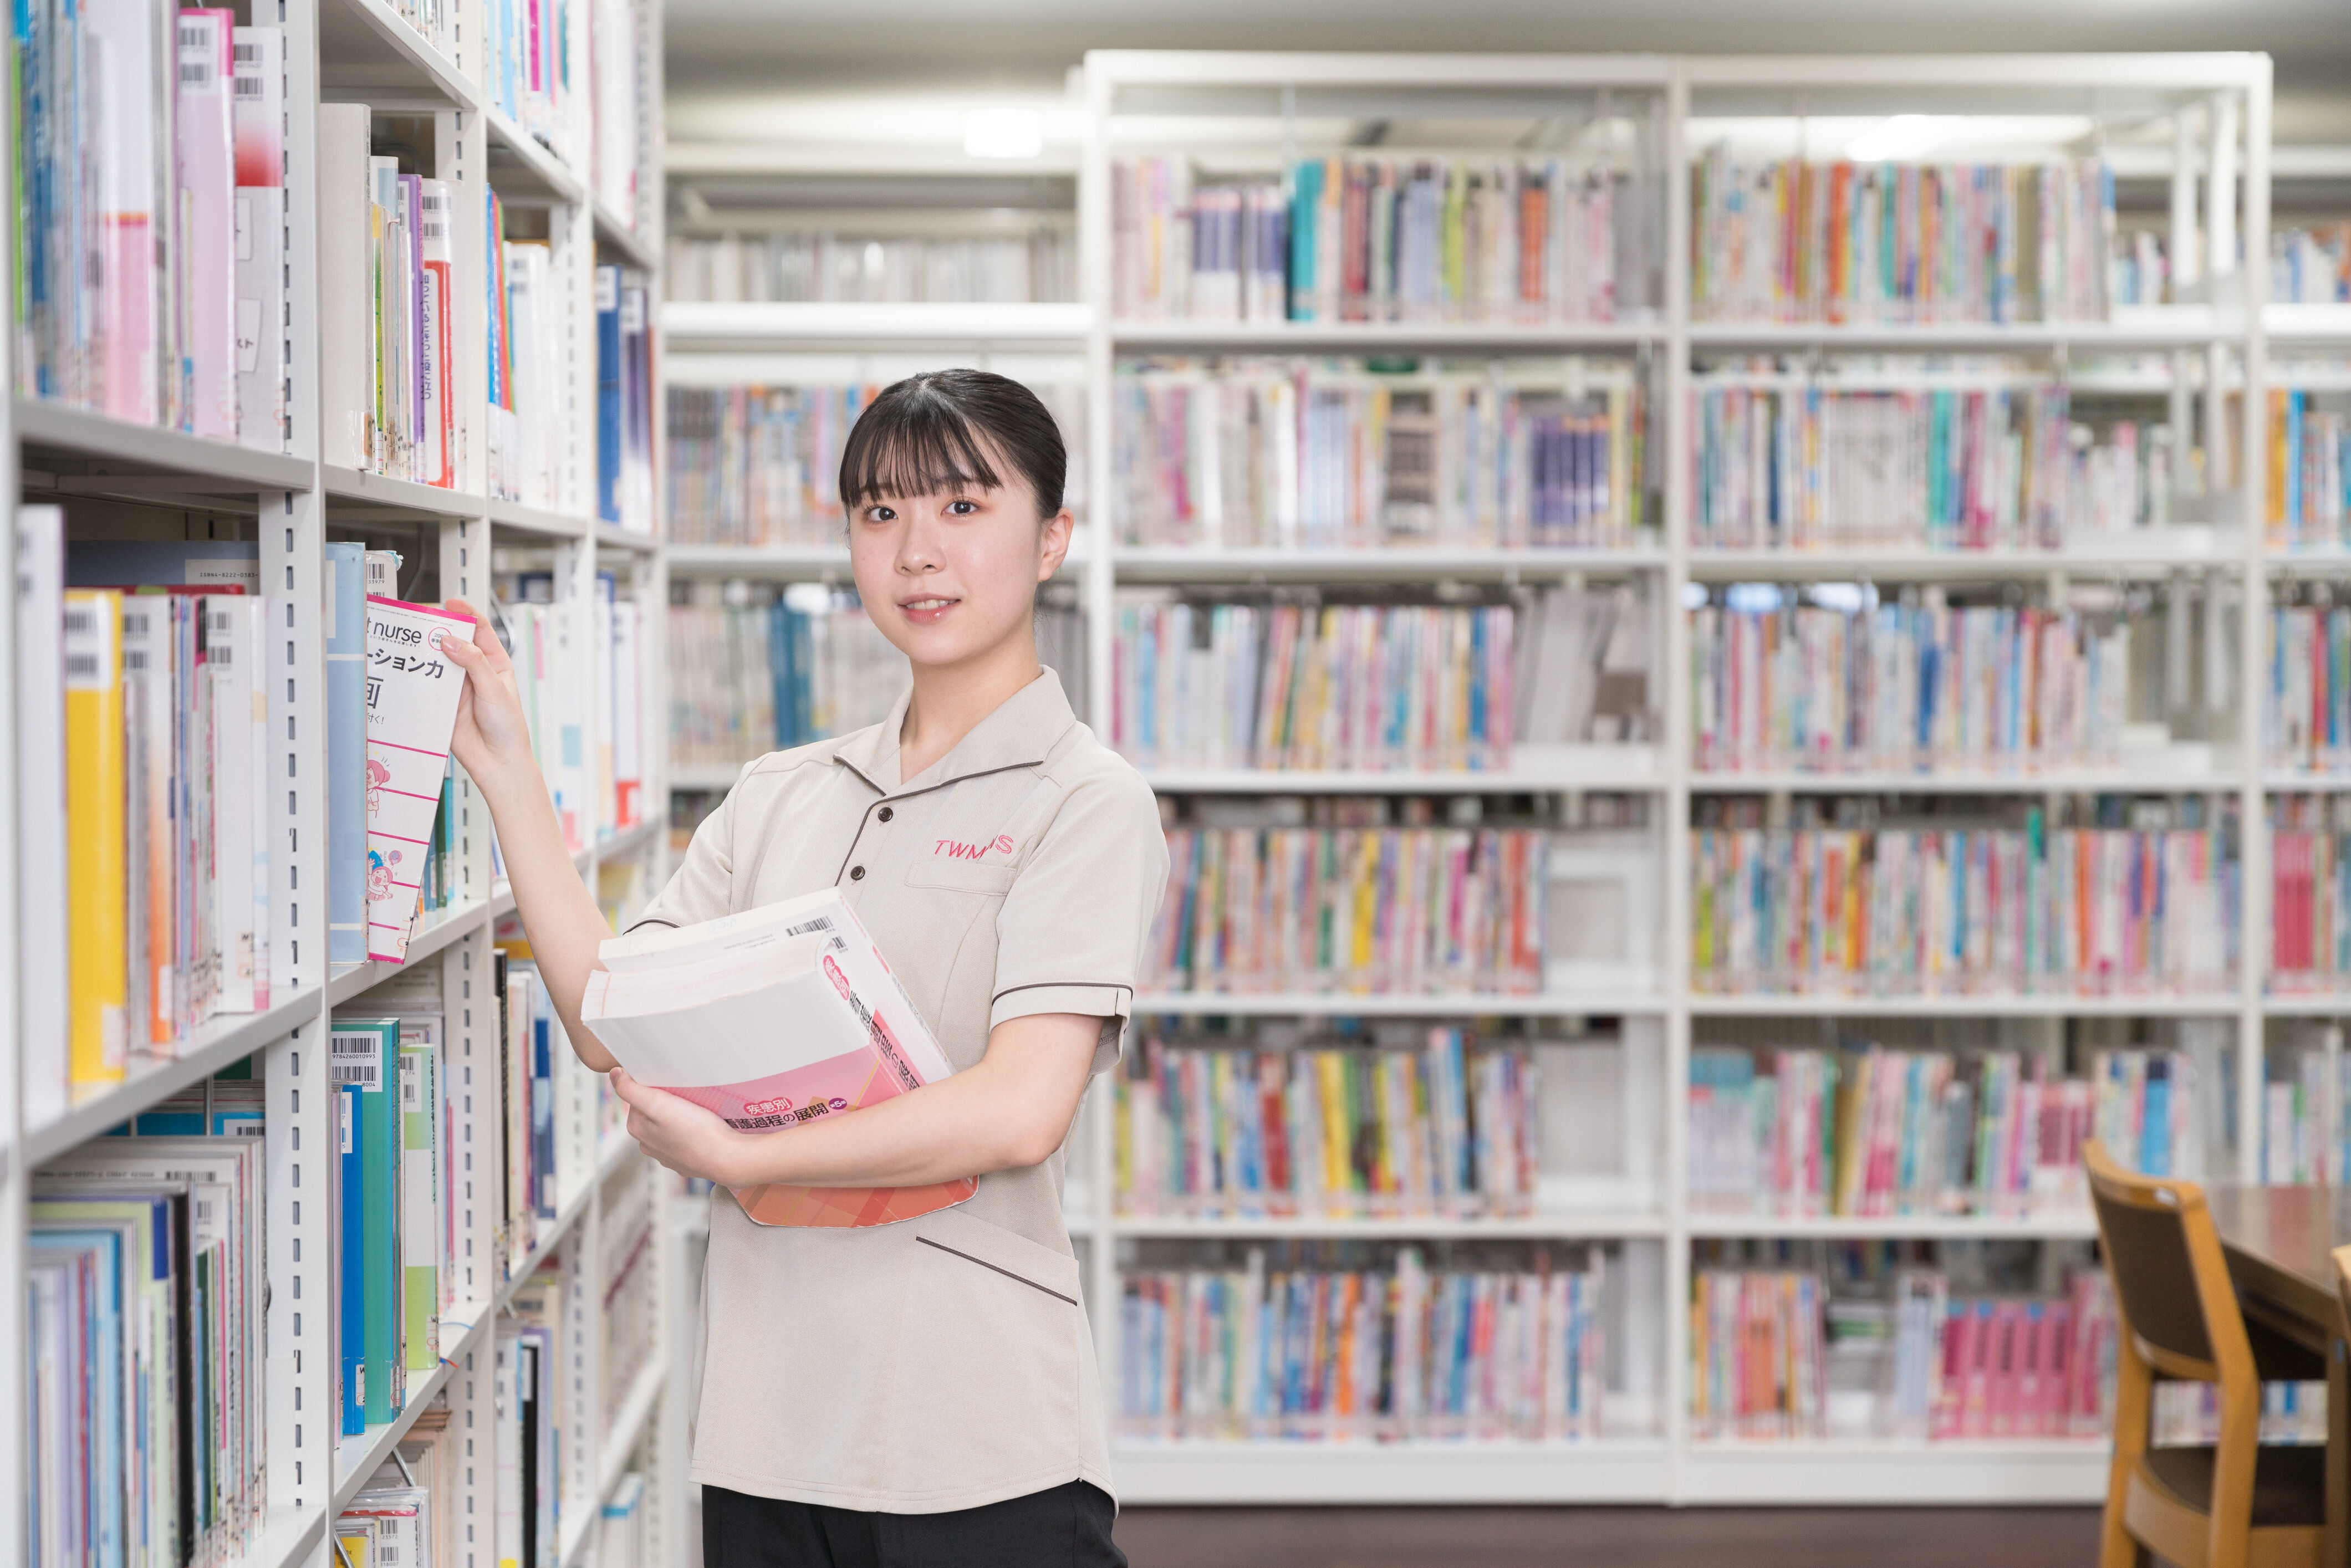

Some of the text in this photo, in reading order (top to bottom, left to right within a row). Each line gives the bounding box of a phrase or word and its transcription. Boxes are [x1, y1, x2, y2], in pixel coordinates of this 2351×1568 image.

[374, 622, 421, 643] nurse
[934, 834, 1014, 861] TWMS
[723, 1102, 829, 1129] 看護過程の展開
[746, 1097, 791, 1115] 疾患別
